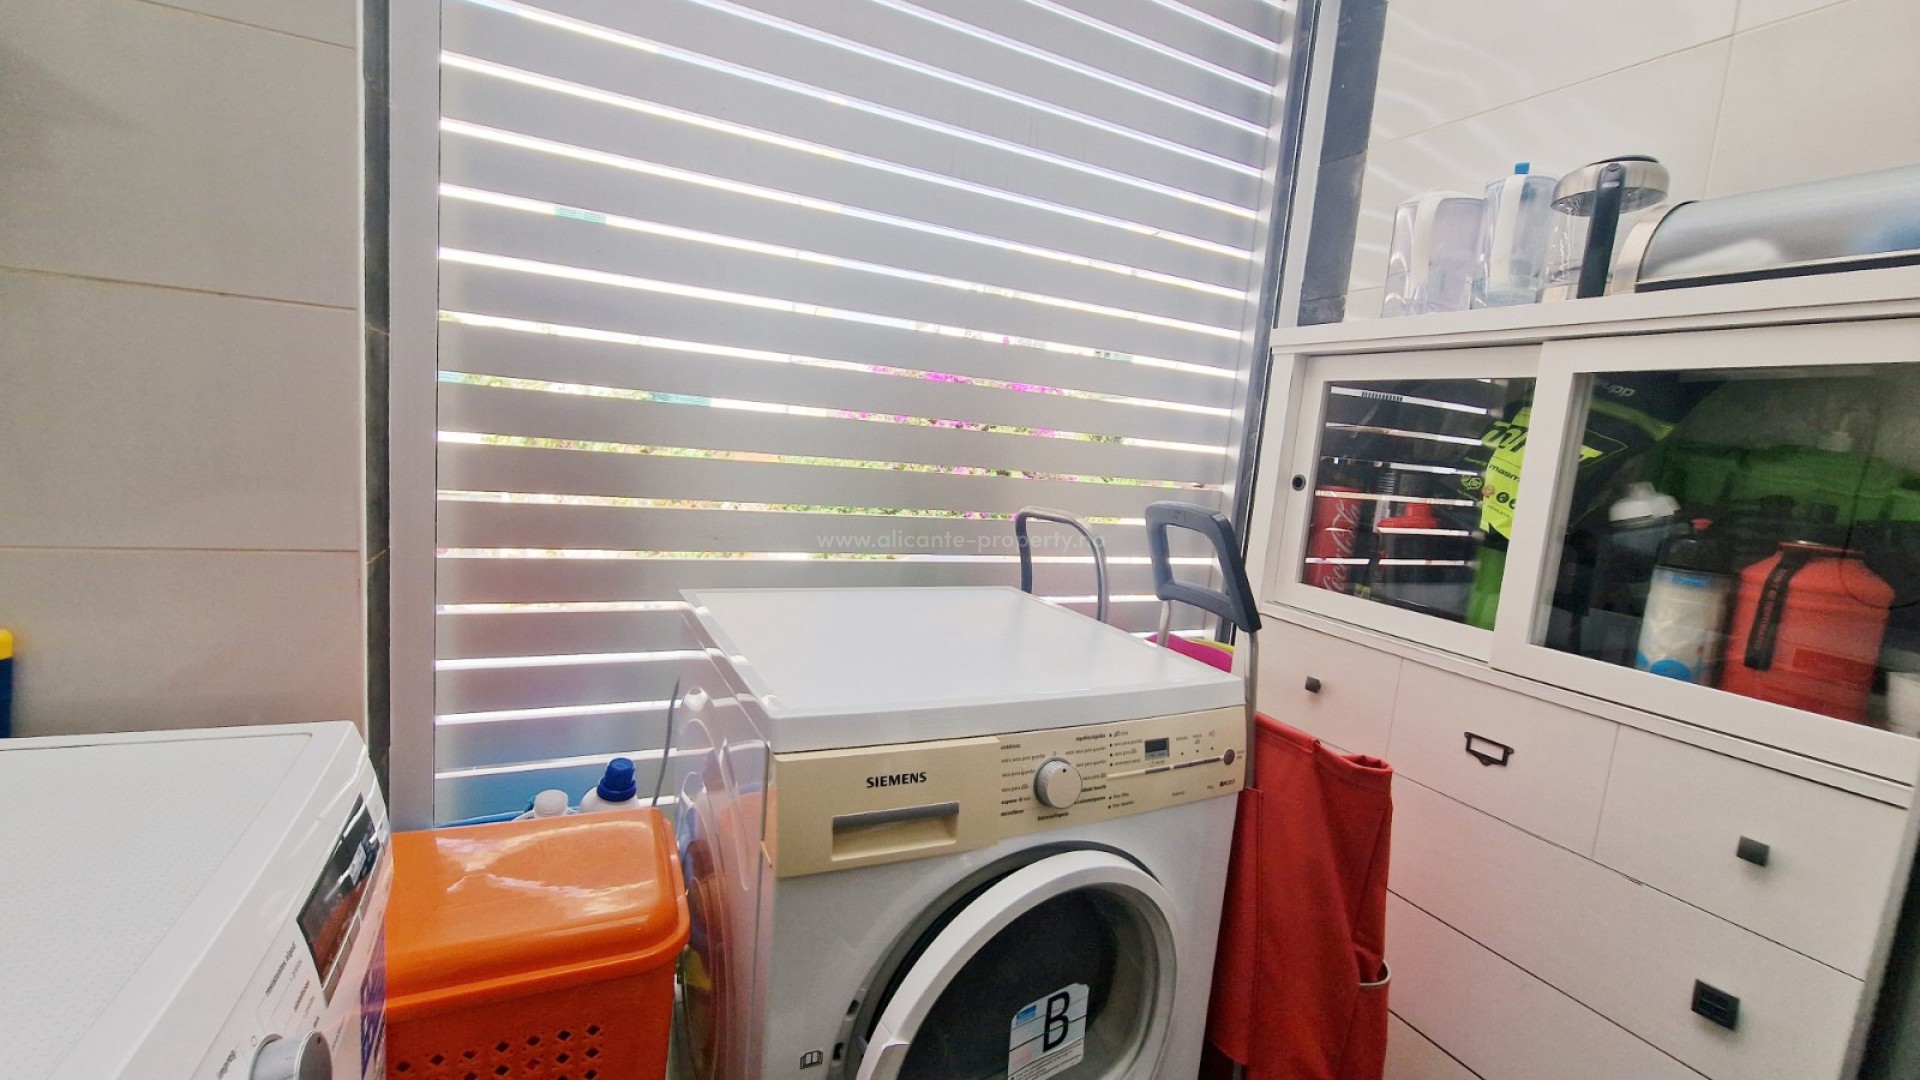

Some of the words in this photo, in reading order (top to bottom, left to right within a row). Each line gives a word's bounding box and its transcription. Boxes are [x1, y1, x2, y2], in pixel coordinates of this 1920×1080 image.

[1489, 464, 1520, 482] masm
[866, 771, 927, 788] SIEMENS
[1043, 990, 1070, 1053] B
